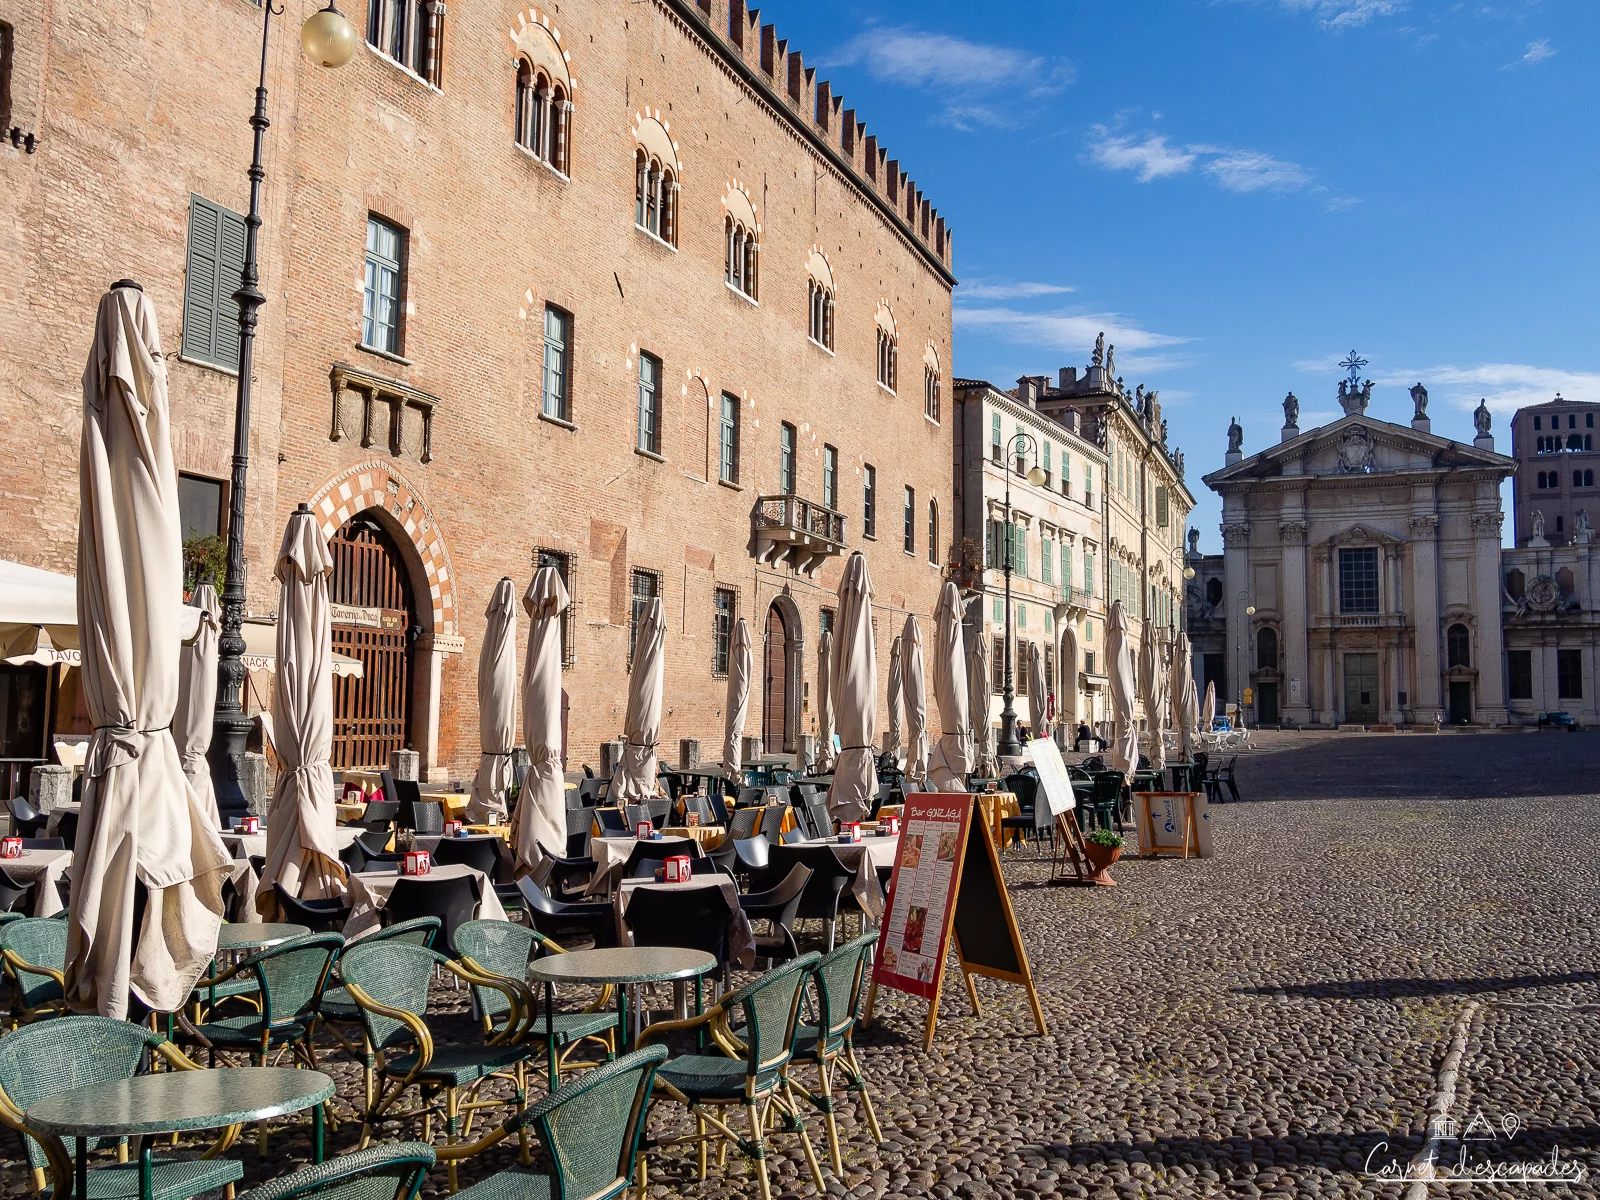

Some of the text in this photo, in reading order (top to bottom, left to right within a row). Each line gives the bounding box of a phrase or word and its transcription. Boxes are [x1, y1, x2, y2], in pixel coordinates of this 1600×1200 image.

[48, 650, 81, 661] TAVO
[242, 656, 269, 668] NACK
[910, 806, 962, 821] Bar GONZAGA
